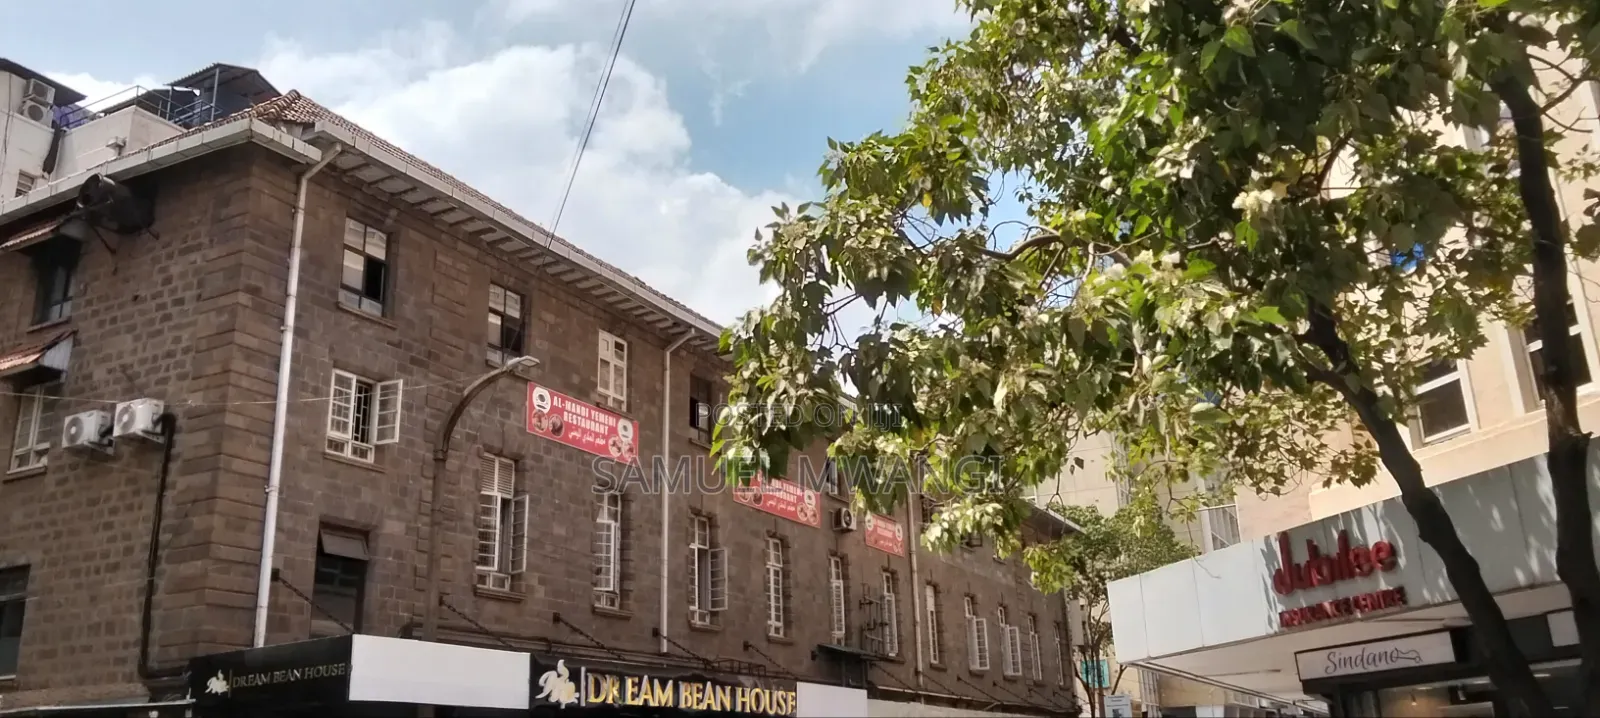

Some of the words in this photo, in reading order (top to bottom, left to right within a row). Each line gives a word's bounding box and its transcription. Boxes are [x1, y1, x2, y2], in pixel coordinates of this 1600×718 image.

[563, 411, 609, 435] RESTAURANT
[1273, 531, 1398, 595] Jubilee
[1351, 586, 1408, 615] CENTRE
[1324, 647, 1401, 675] Sindano
[233, 672, 271, 688] DREAM
[273, 668, 302, 684] BEAN
[304, 663, 346, 680] HOUSE
[678, 680, 732, 713] BEAN
[735, 687, 796, 717] HOUSE
